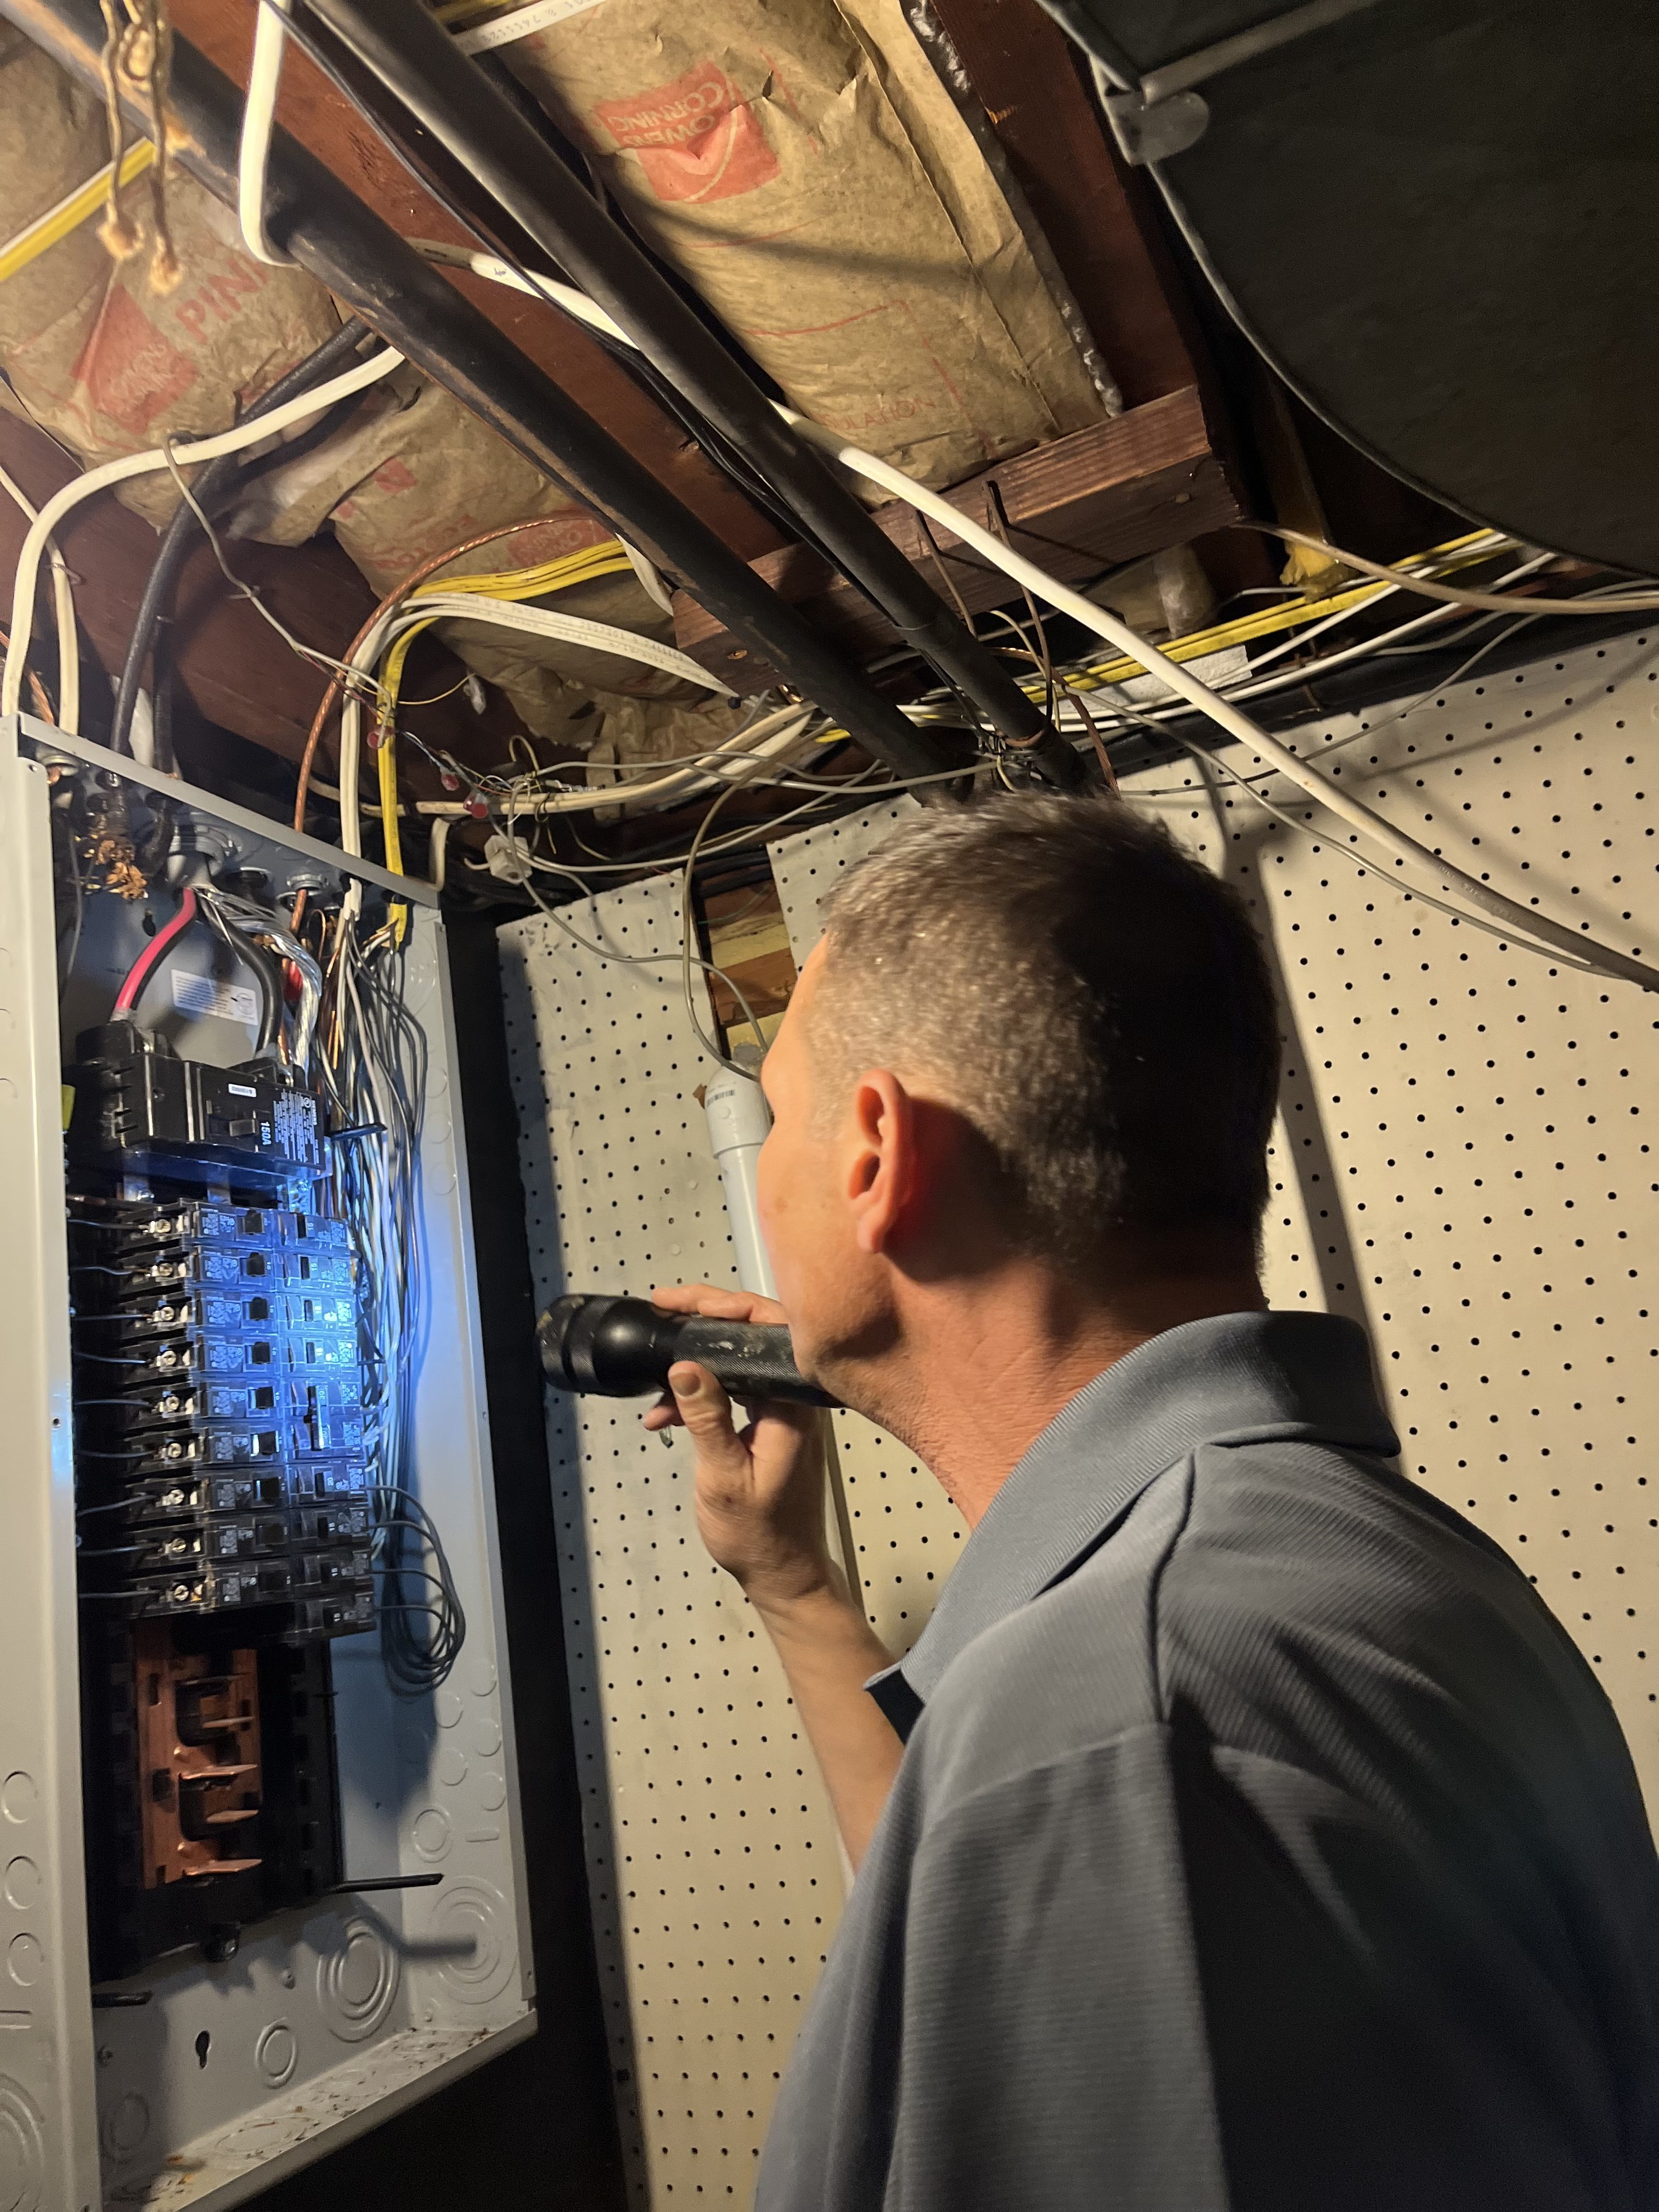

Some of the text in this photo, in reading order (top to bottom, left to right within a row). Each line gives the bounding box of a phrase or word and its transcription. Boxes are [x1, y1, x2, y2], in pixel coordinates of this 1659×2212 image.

[607, 81, 724, 132] CORNING
[623, 114, 715, 146] OWENS
[261, 1121, 272, 1146] 150A
